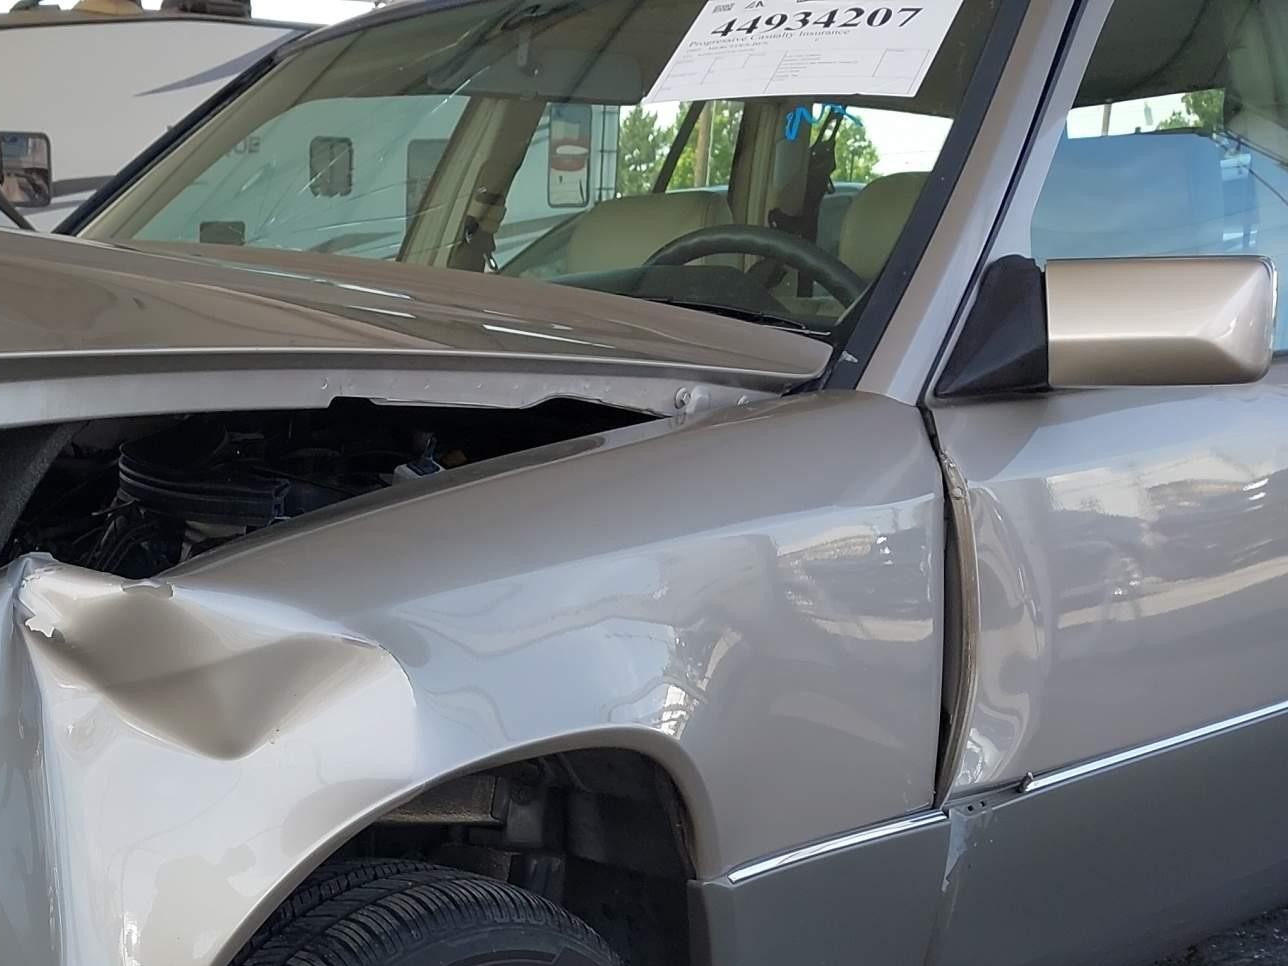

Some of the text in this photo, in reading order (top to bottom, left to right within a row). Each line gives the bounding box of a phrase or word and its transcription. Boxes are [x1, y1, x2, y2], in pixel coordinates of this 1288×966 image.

[711, 7, 924, 37] 44934207
[750, 31, 793, 42] Casualty
[799, 29, 851, 38] Insurance
